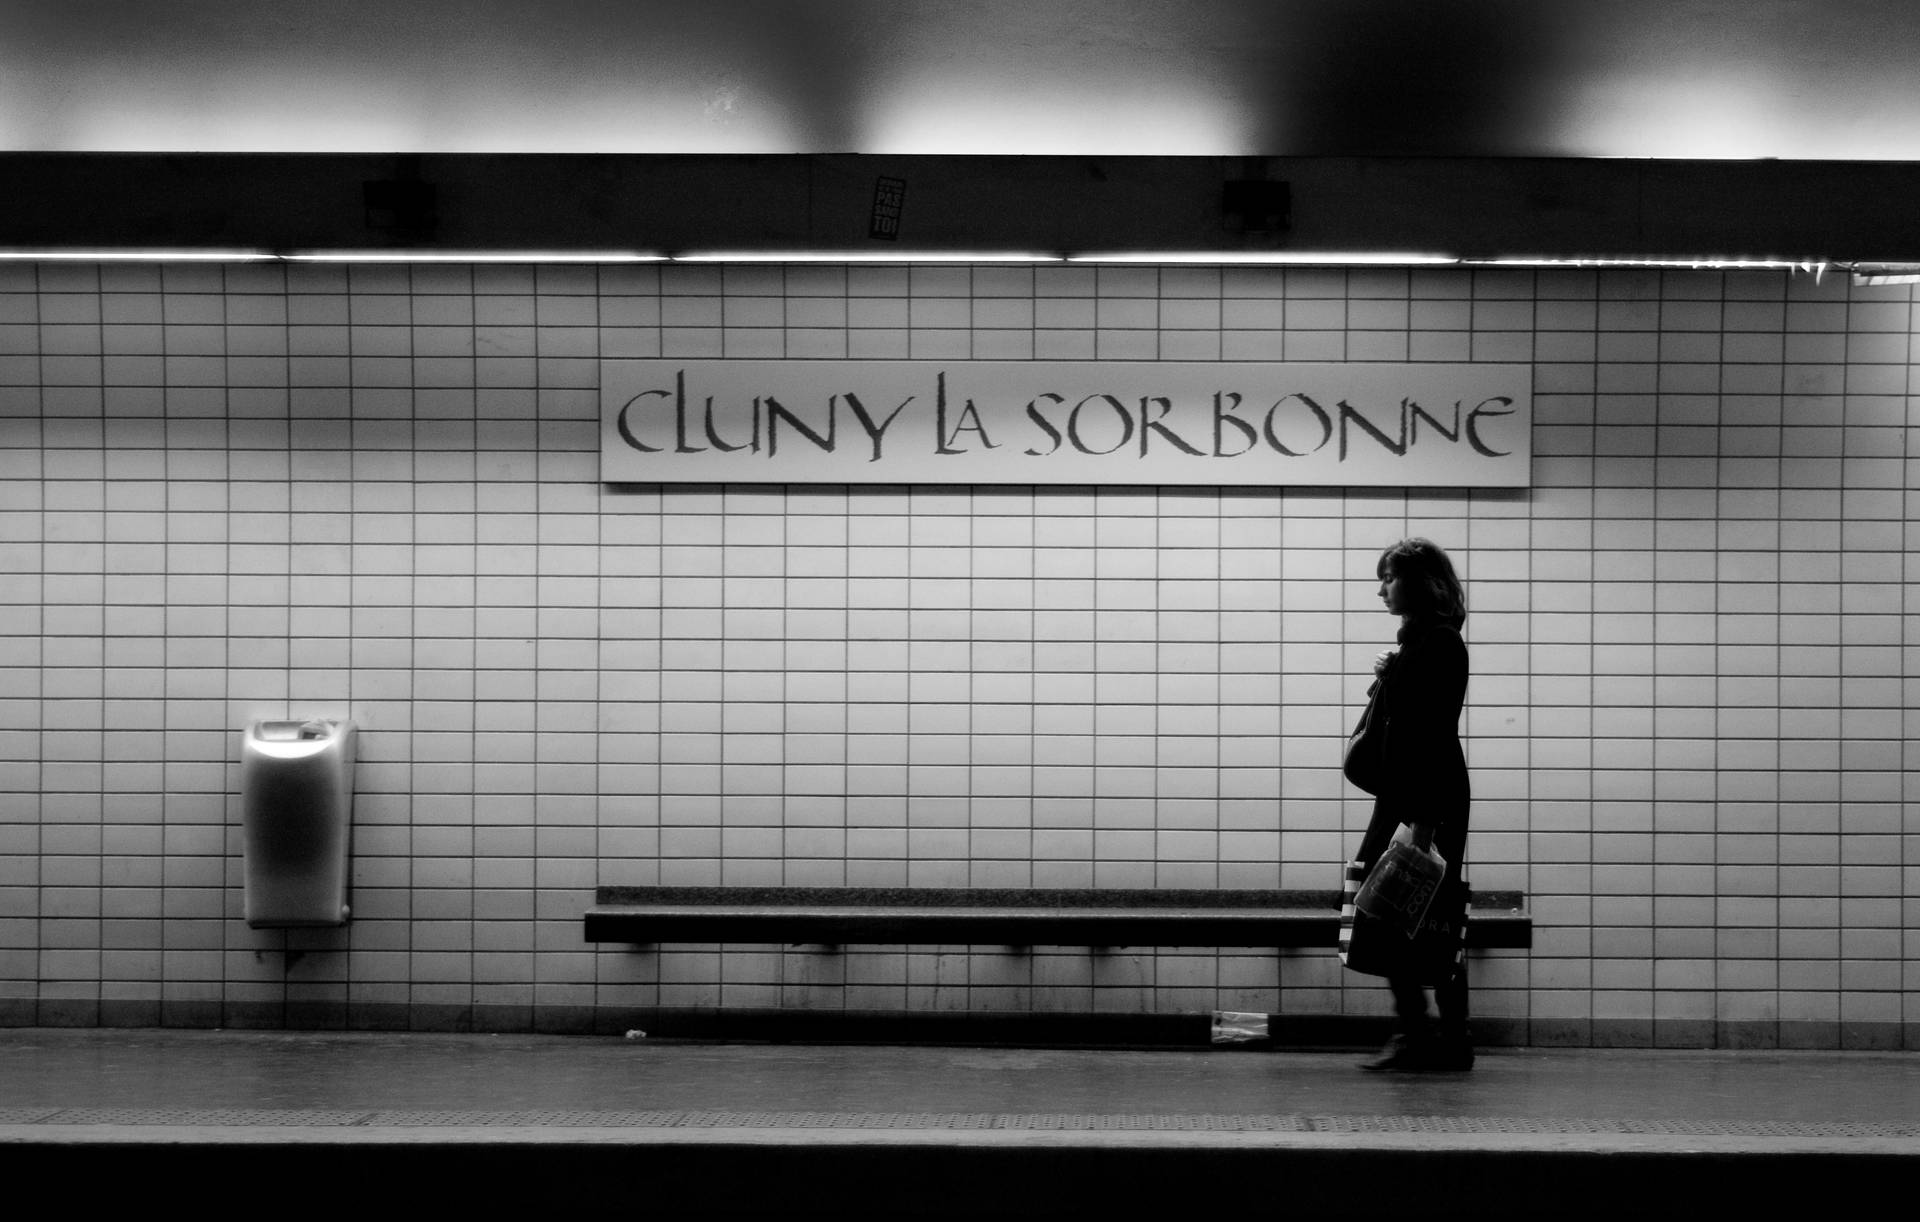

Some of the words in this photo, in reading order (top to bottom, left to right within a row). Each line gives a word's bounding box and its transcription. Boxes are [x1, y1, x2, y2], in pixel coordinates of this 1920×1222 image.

[617, 369, 916, 463] CLUNY
[934, 371, 1003, 456] LA
[1023, 390, 1517, 462] SORBONNE
